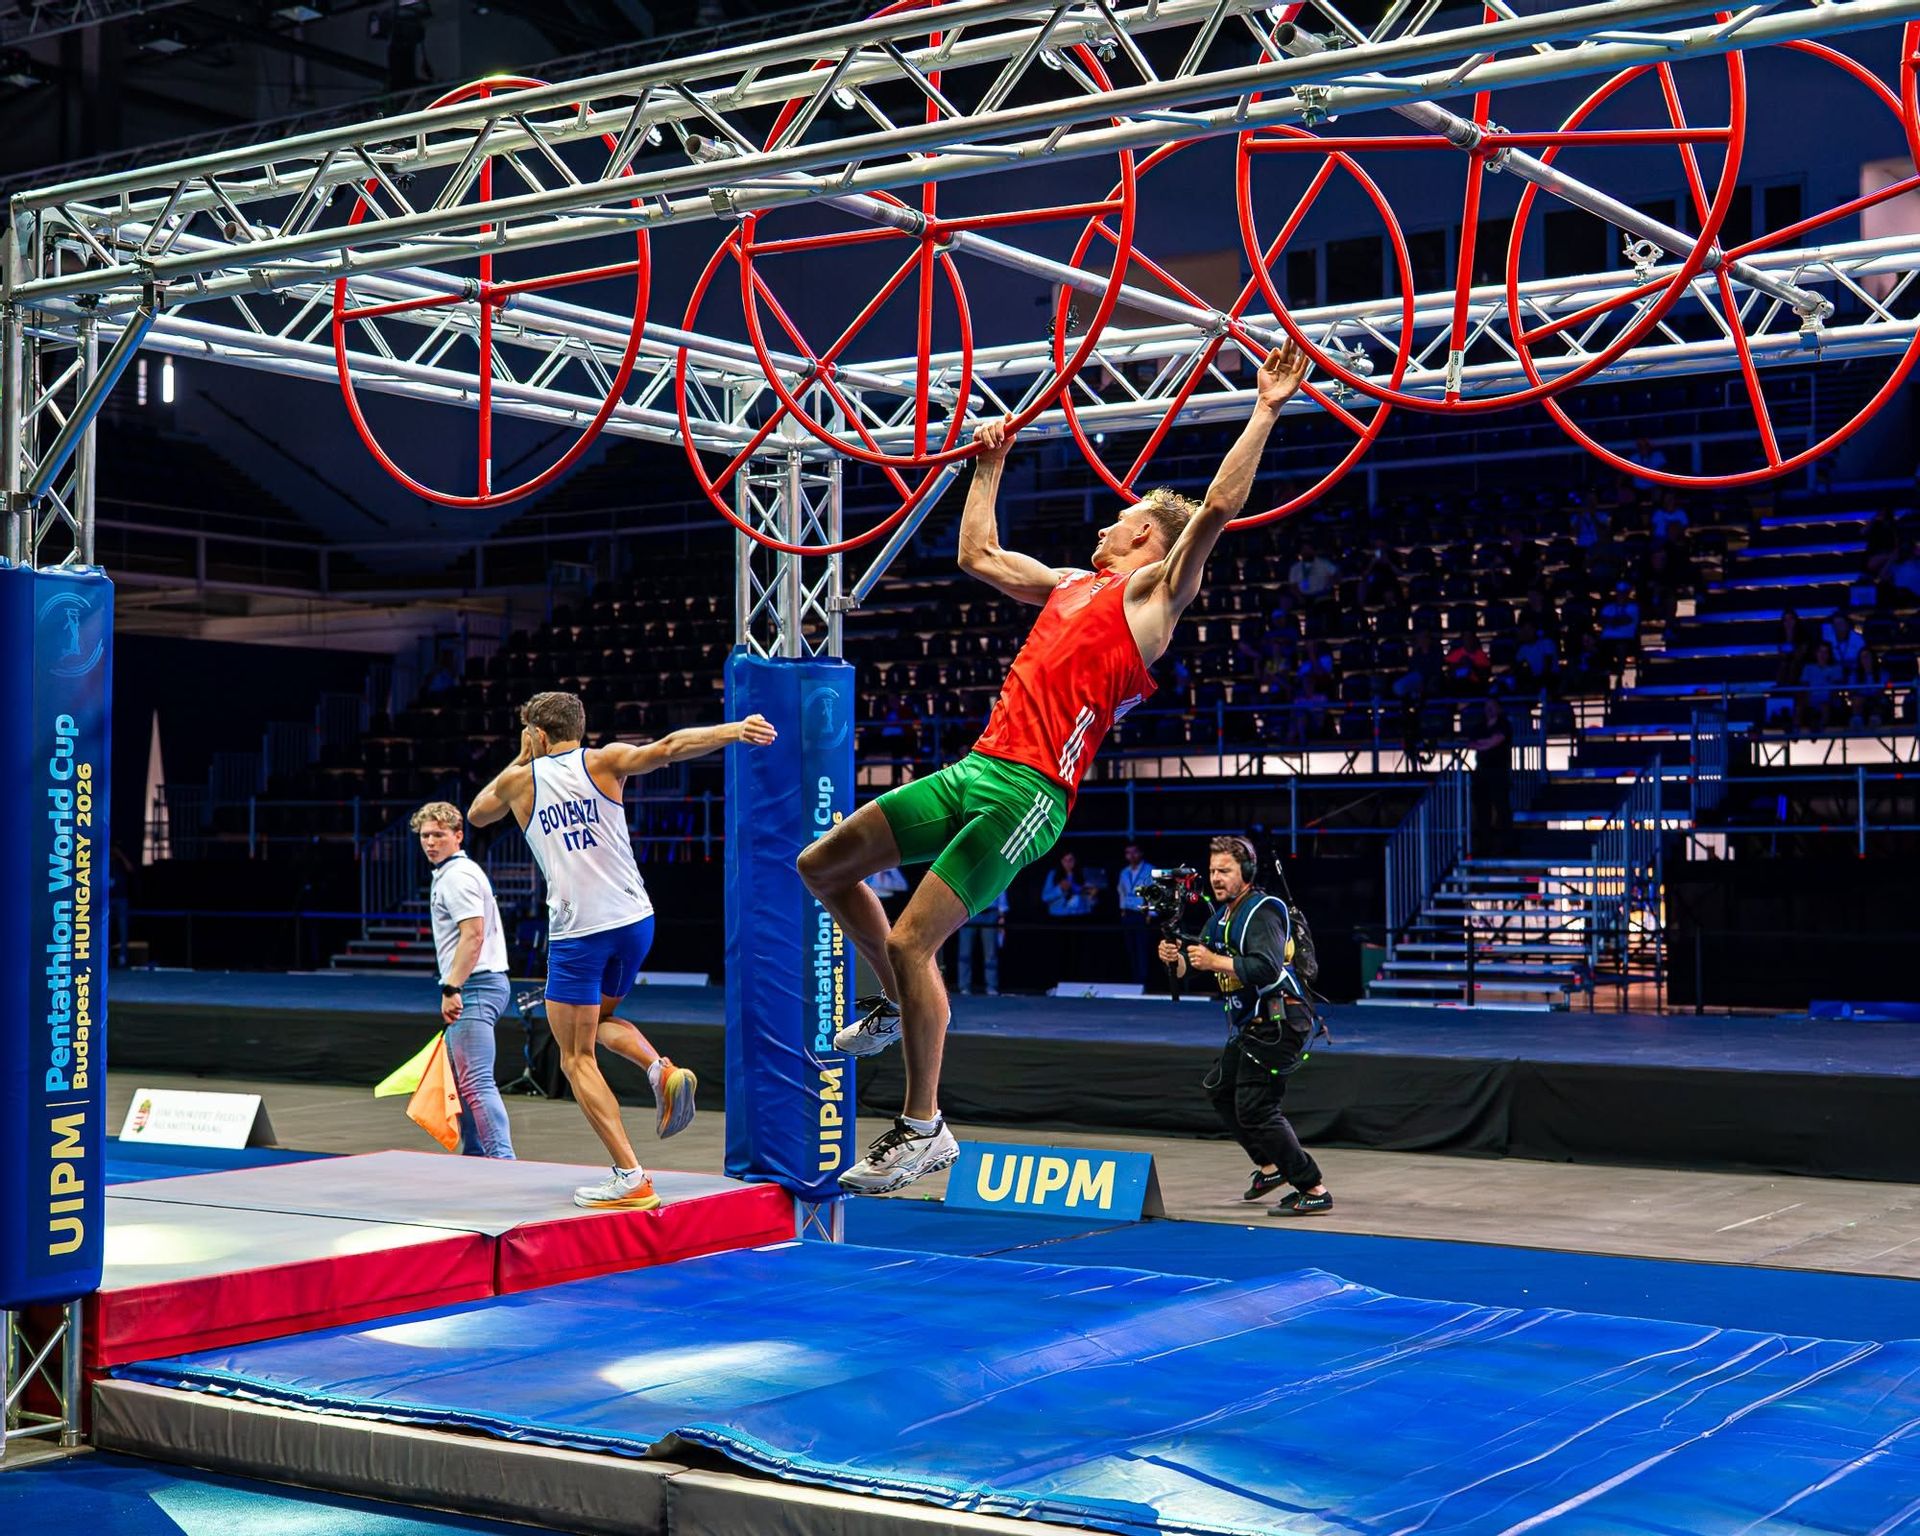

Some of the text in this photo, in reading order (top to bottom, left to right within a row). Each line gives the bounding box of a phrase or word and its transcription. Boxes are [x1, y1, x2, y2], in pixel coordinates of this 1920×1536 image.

[538, 798, 600, 836] BOVENZI
[562, 828, 599, 852] ITA
[814, 776, 835, 826] Cup
[73, 762, 92, 1090] Budapest, HUNGARY 2026
[45, 714, 86, 1257] UIPM Pentathlon World Cup
[814, 911, 832, 1052] Pentathlon
[833, 961, 845, 1040] dapest,
[819, 1067, 844, 1171] UIPM
[976, 1153, 1117, 1210] UIPM
